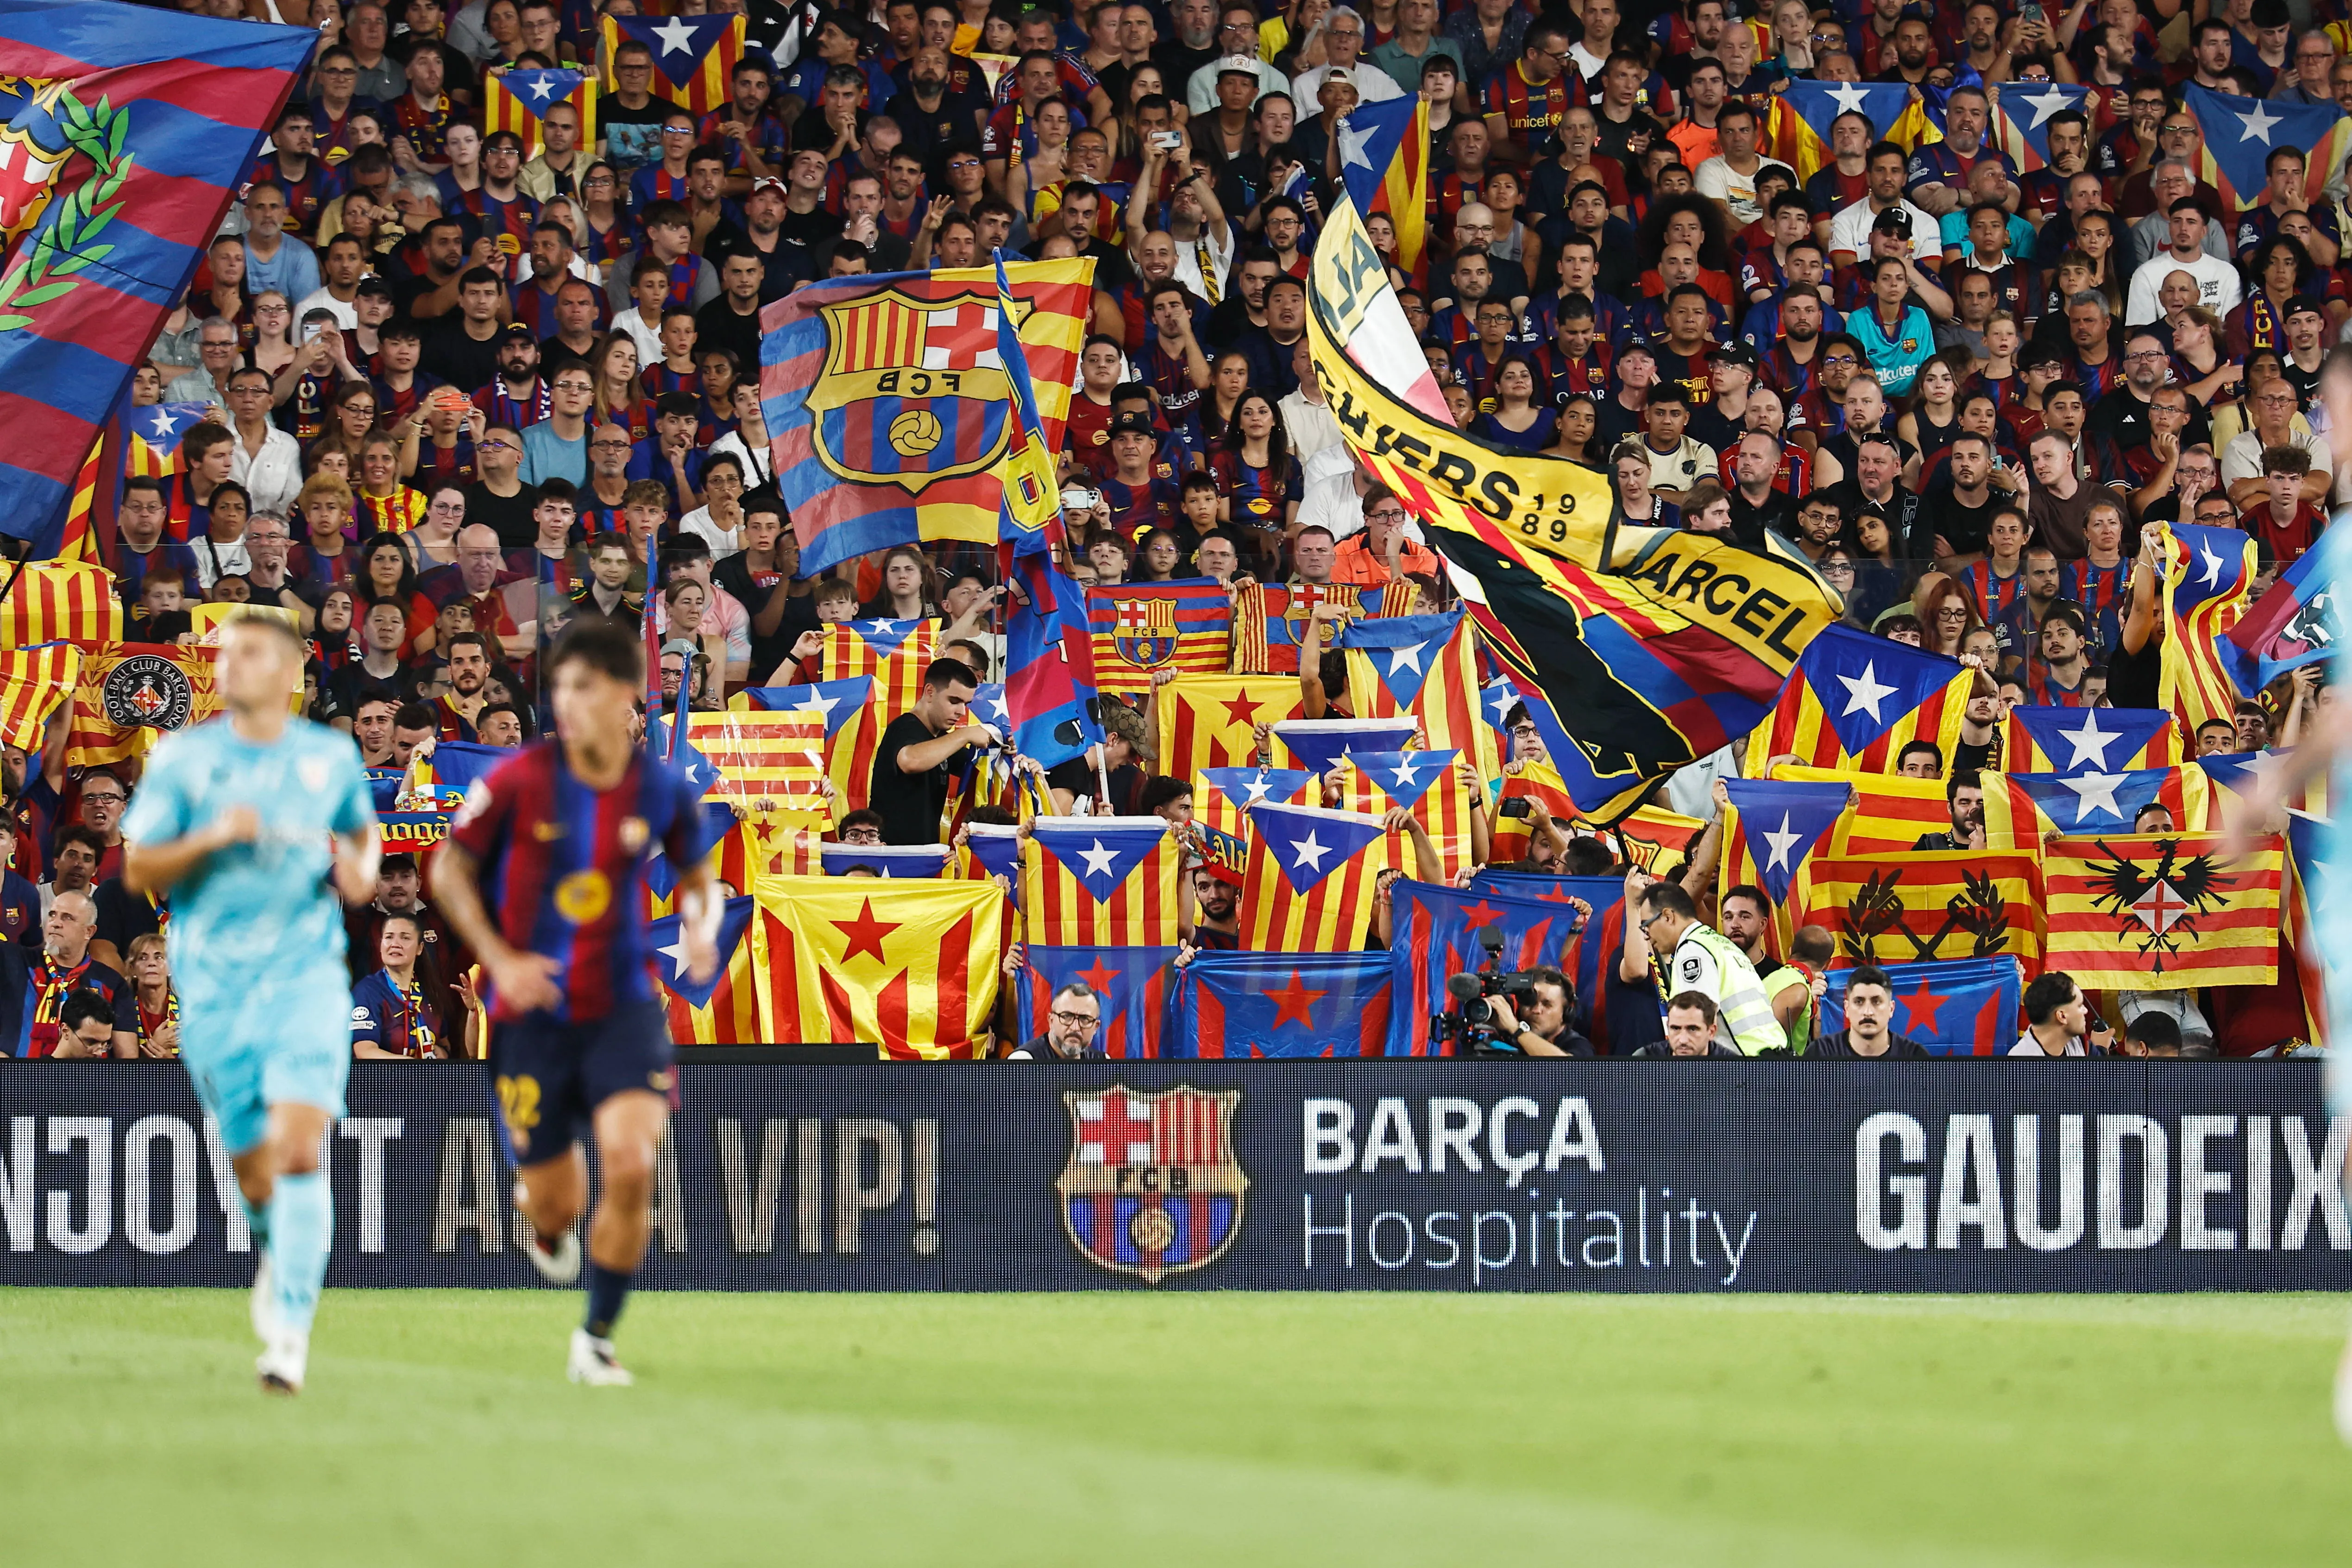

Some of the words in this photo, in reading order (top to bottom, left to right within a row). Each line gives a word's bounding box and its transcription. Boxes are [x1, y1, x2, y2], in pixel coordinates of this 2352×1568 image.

[1510, 115, 1550, 129] unicef
[1505, 334, 1518, 342] be
[298, 381, 321, 415] FC
[1654, 494, 1662, 520] MICKEY
[1133, 628, 1158, 637] FCB
[131, 660, 161, 672] CLUB
[162, 666, 187, 728] BARCELONA
[1303, 1096, 1605, 1189] BARÇA
[717, 1117, 939, 1256] VIP!
[1304, 1187, 1757, 1286] Hospitality
